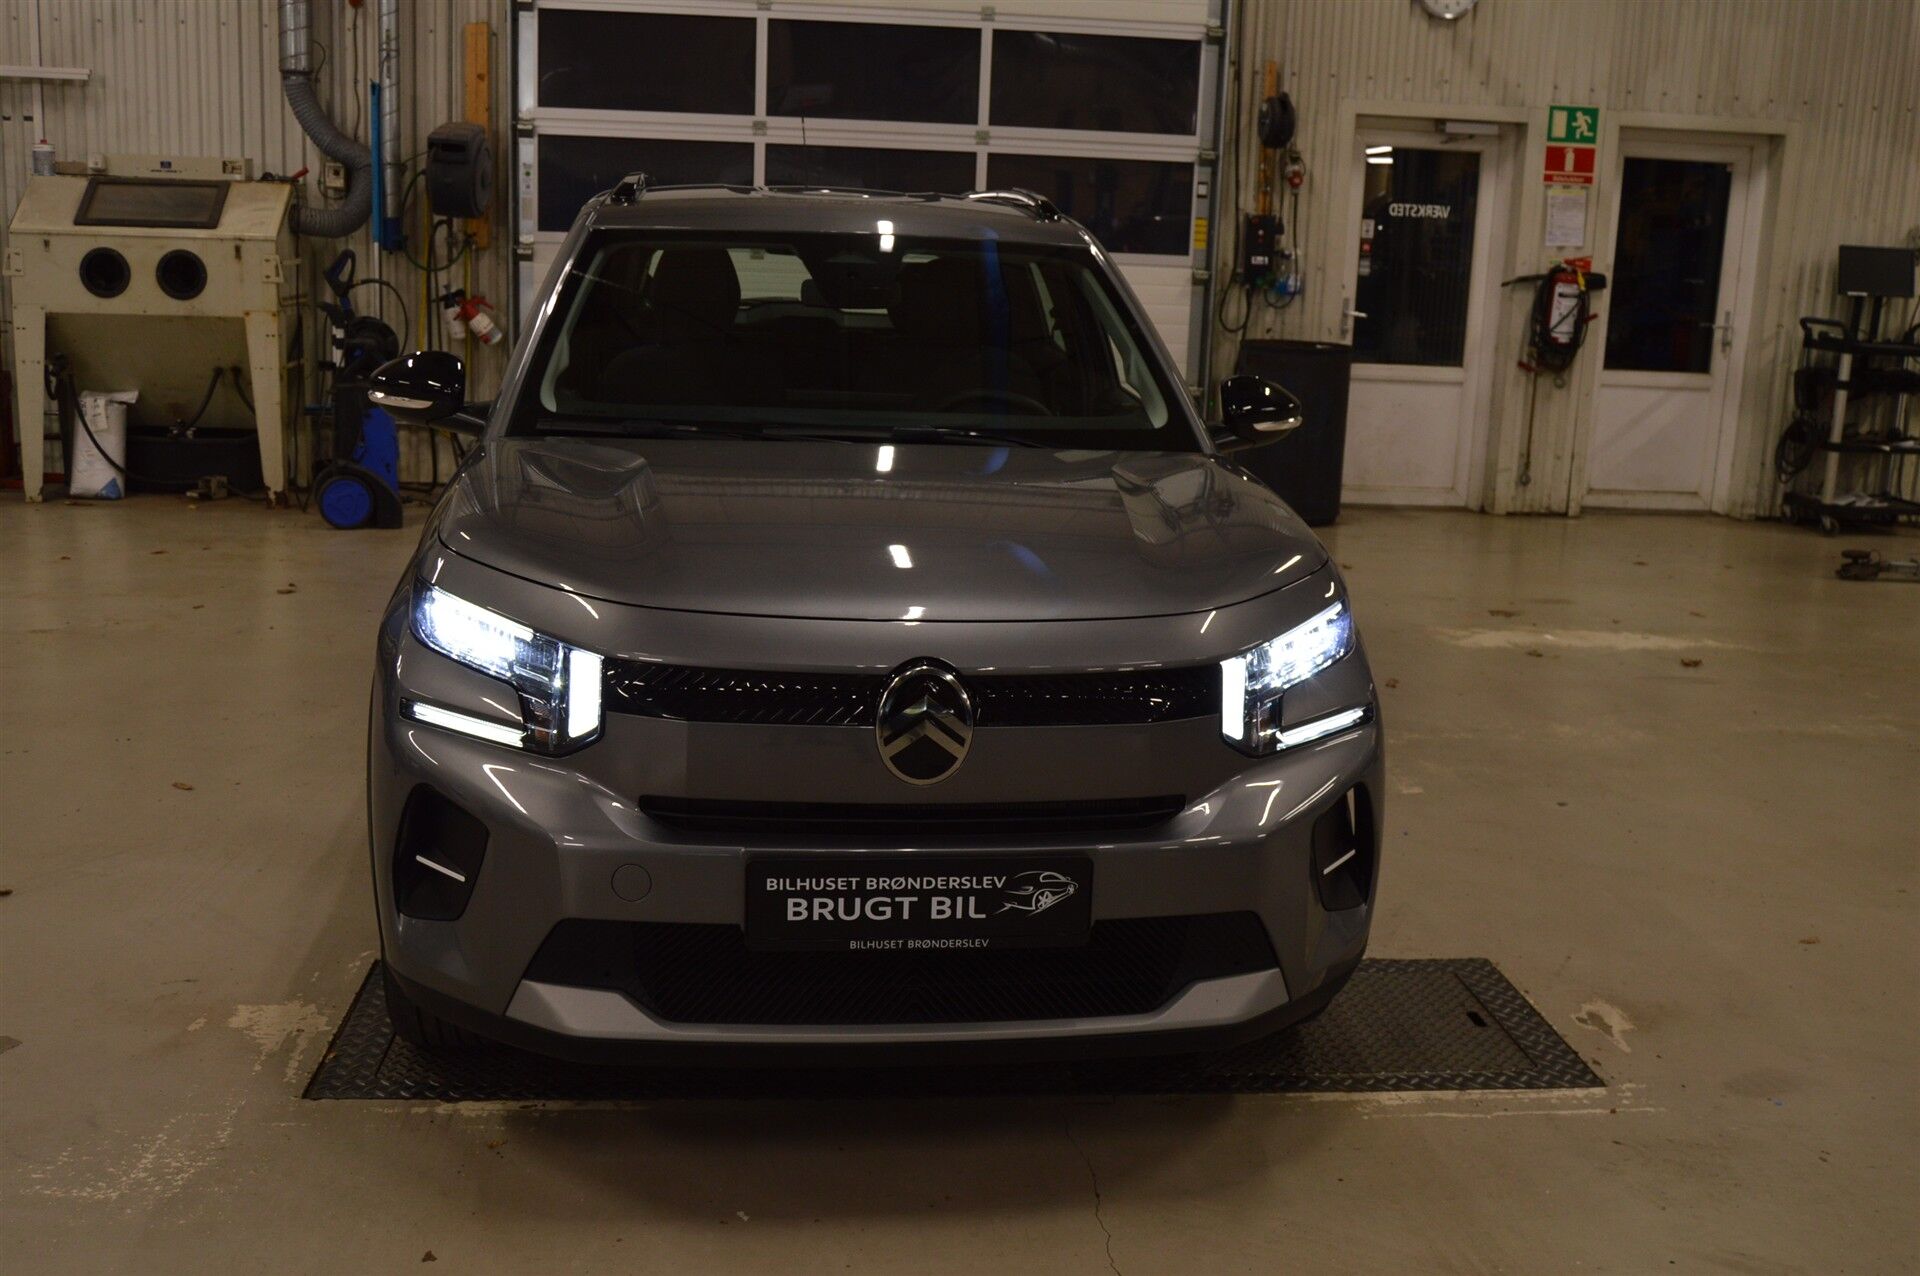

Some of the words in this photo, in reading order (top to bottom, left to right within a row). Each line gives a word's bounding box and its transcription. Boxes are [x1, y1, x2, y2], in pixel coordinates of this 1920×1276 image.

[766, 877, 860, 891] BILHUSET
[865, 875, 1007, 891] BRØNDERSLEV
[786, 896, 918, 921] BRUGT
[930, 896, 986, 919] BIL
[849, 939, 904, 950] BILHUSET
[907, 938, 990, 949] BRØNDERSLEV
